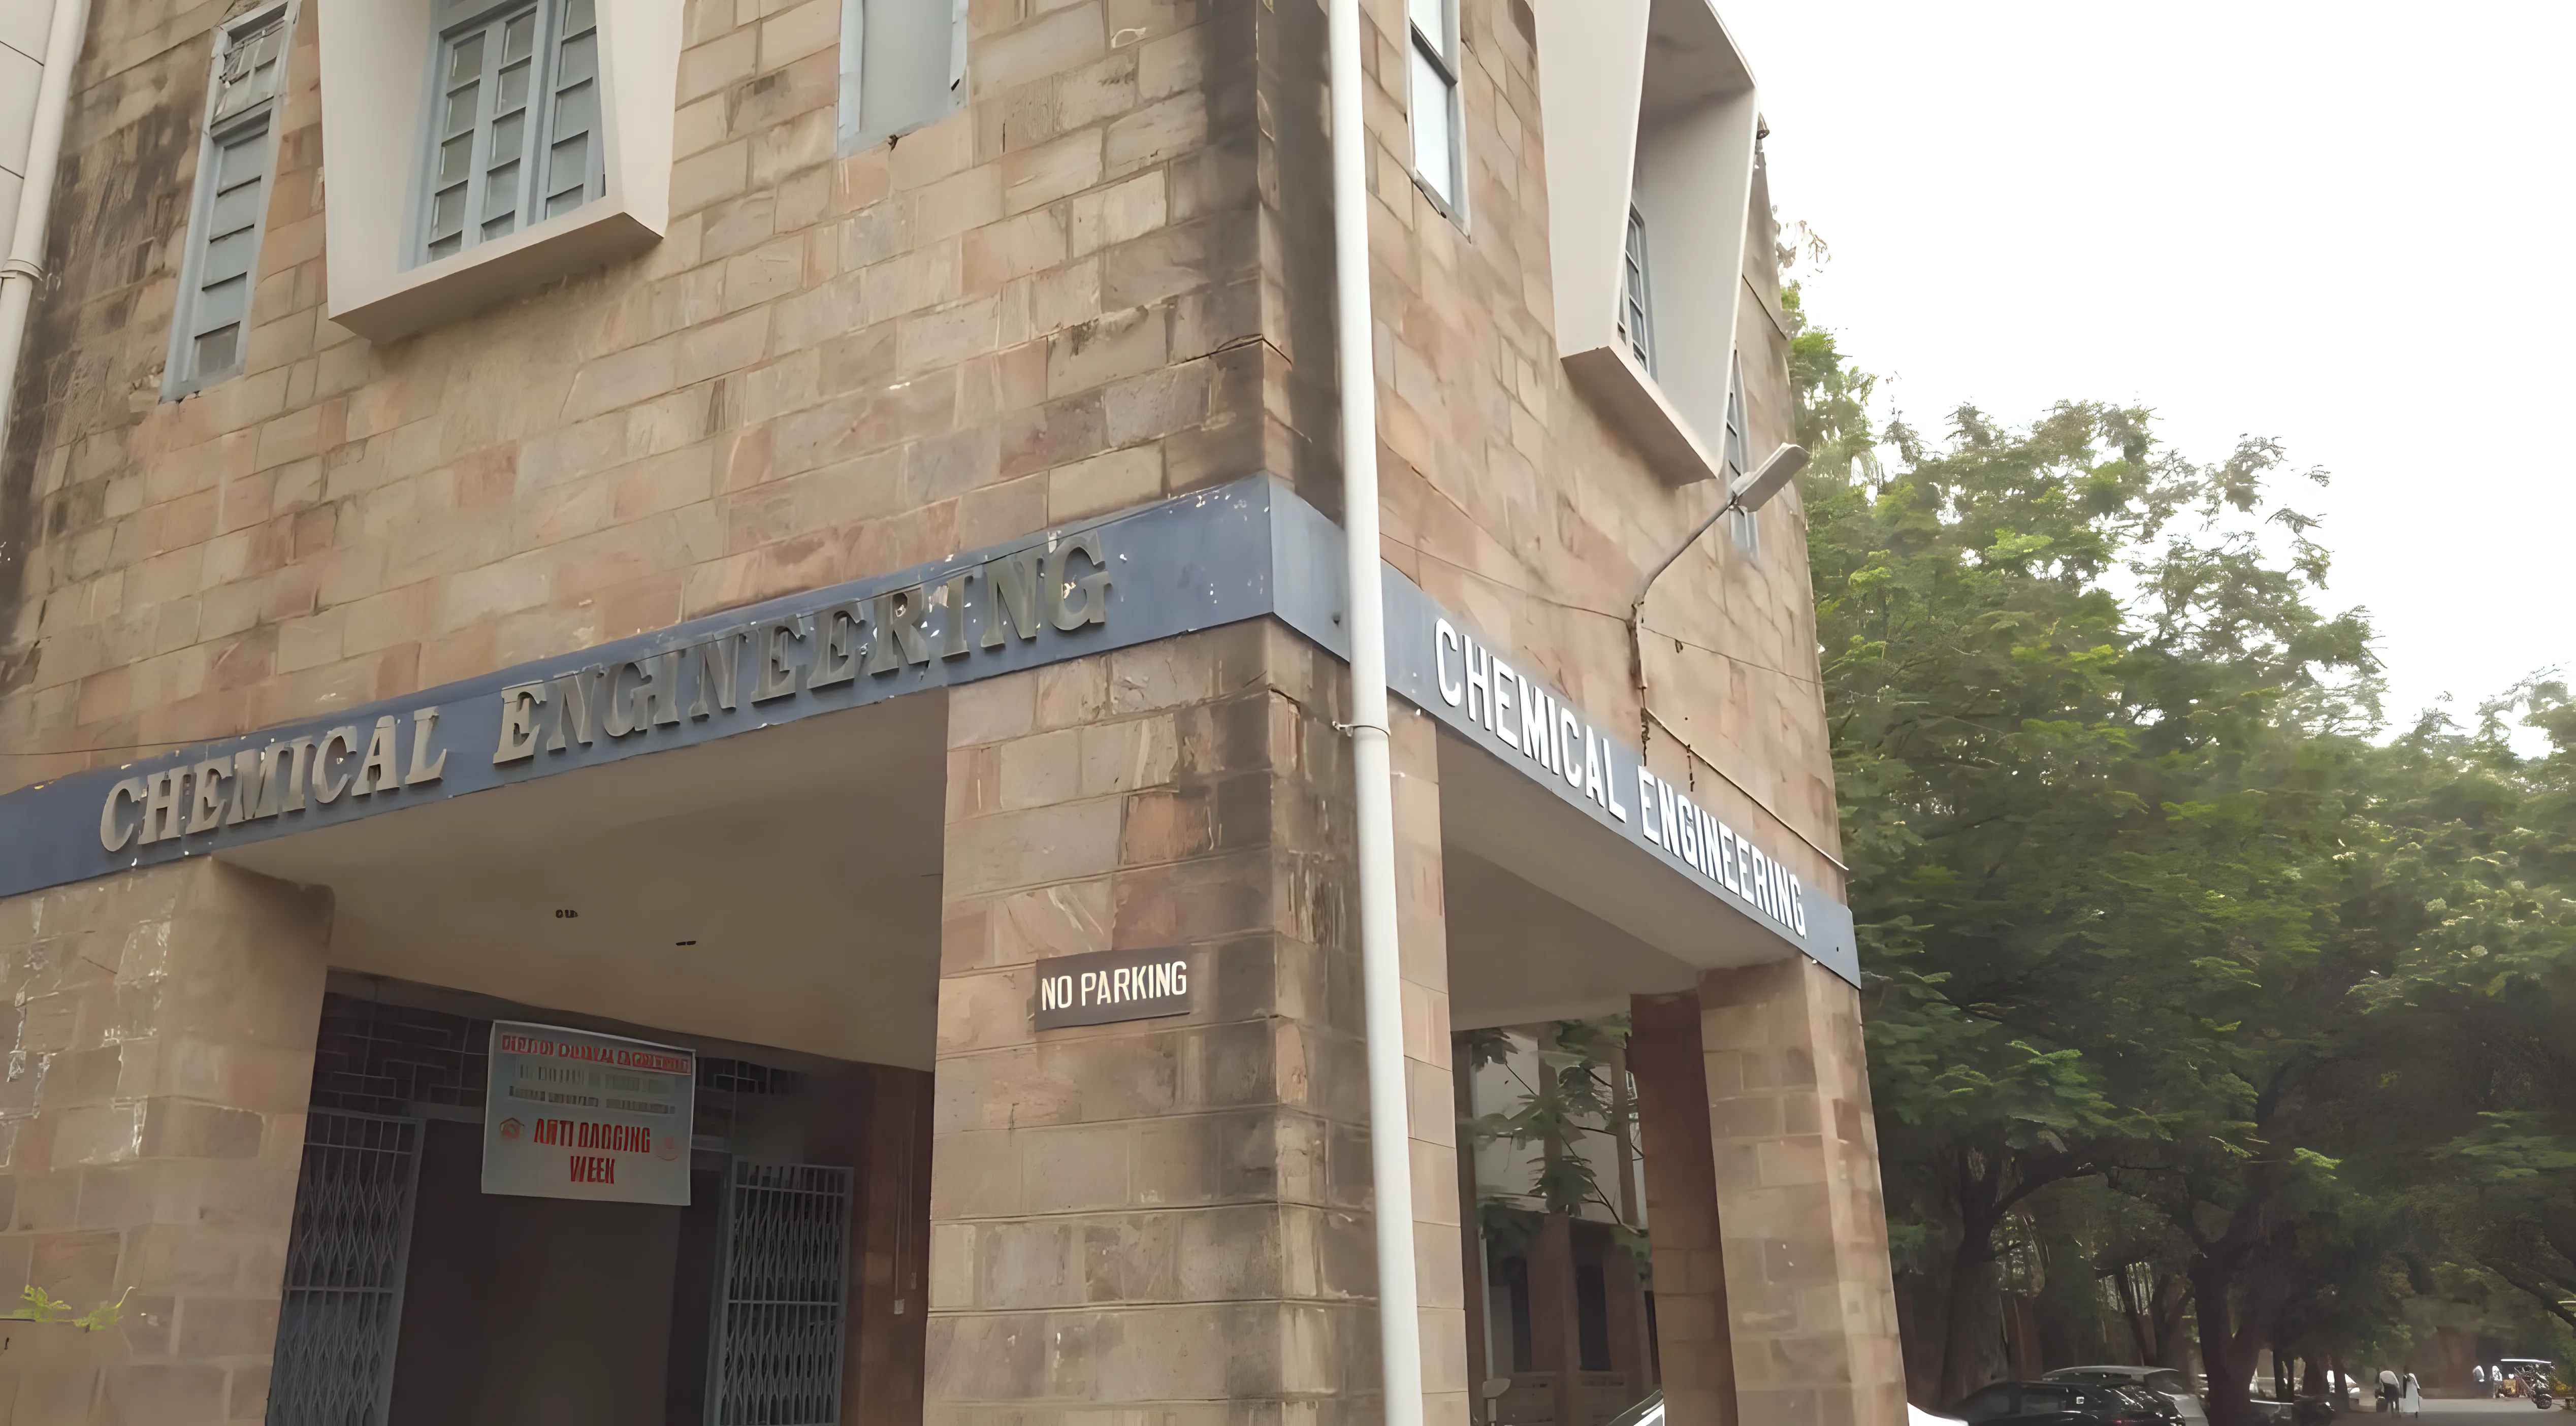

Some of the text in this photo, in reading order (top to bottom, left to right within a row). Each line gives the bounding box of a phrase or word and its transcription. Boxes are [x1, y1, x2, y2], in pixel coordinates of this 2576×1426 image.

[101, 530, 1113, 852] CHEMICAL ENGINEERING
[1434, 618, 1807, 939] CHEMICAL ENGINEERING
[1042, 961, 1187, 1011] NO PARKING
